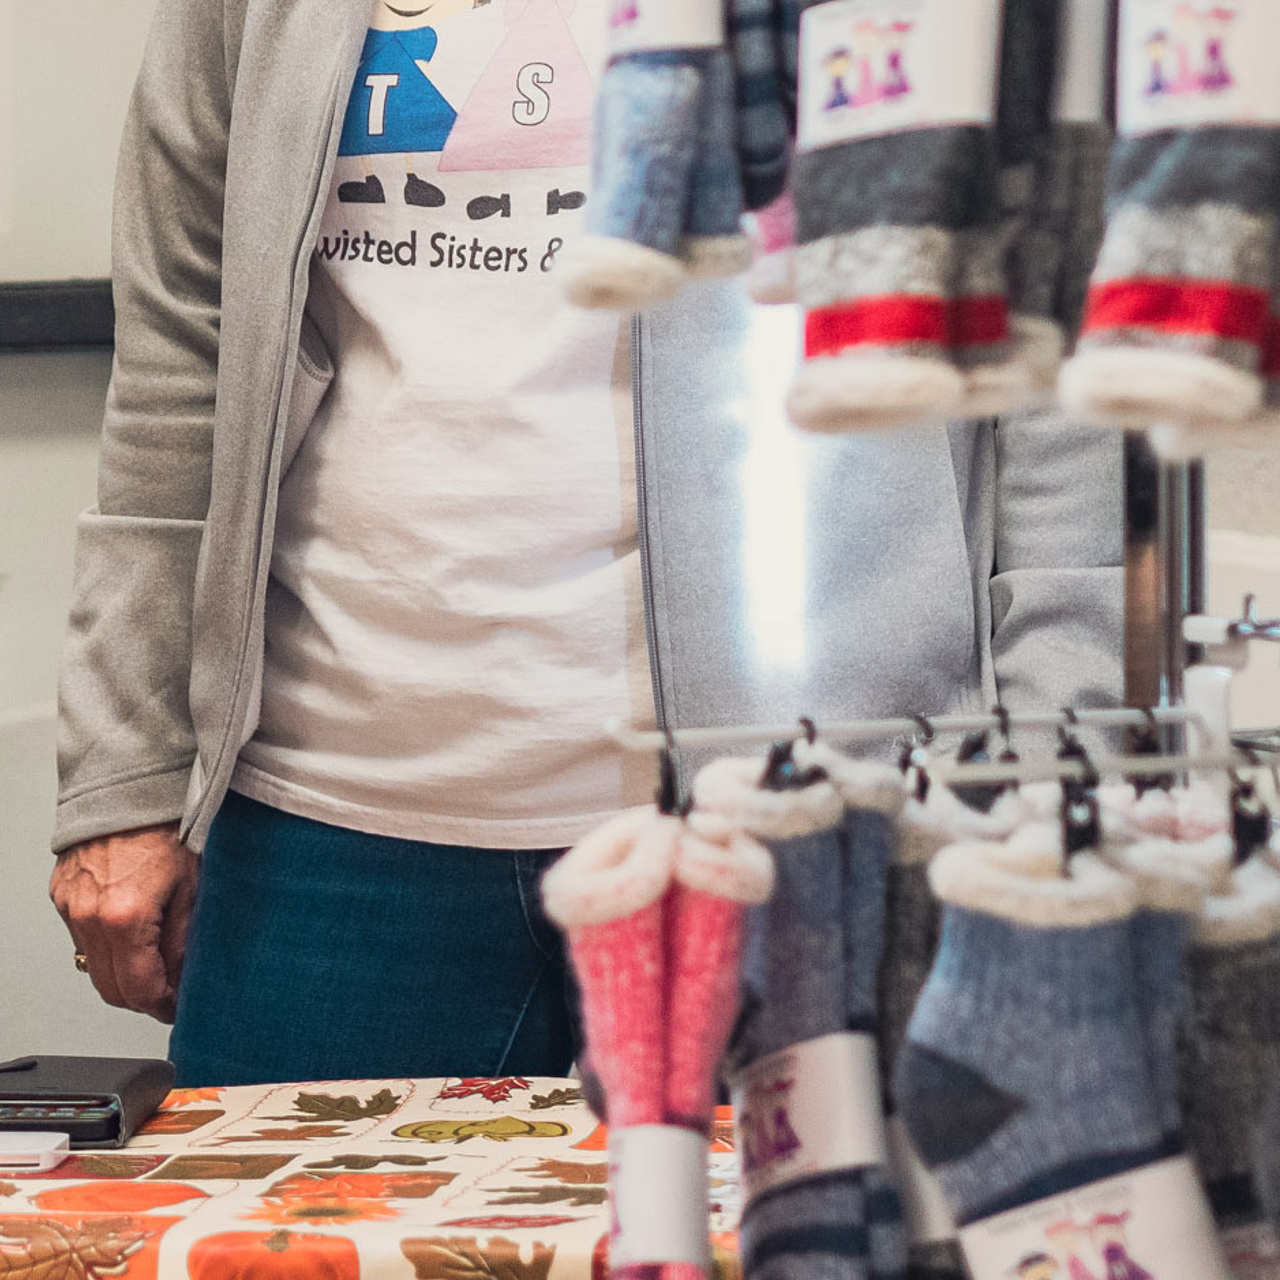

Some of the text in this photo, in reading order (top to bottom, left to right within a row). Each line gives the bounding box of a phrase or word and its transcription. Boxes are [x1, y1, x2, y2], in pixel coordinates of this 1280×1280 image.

[364, 72, 400, 136] T
[512, 62, 553, 126] S
[316, 228, 417, 266] wisted
[429, 231, 528, 272] Sisters
